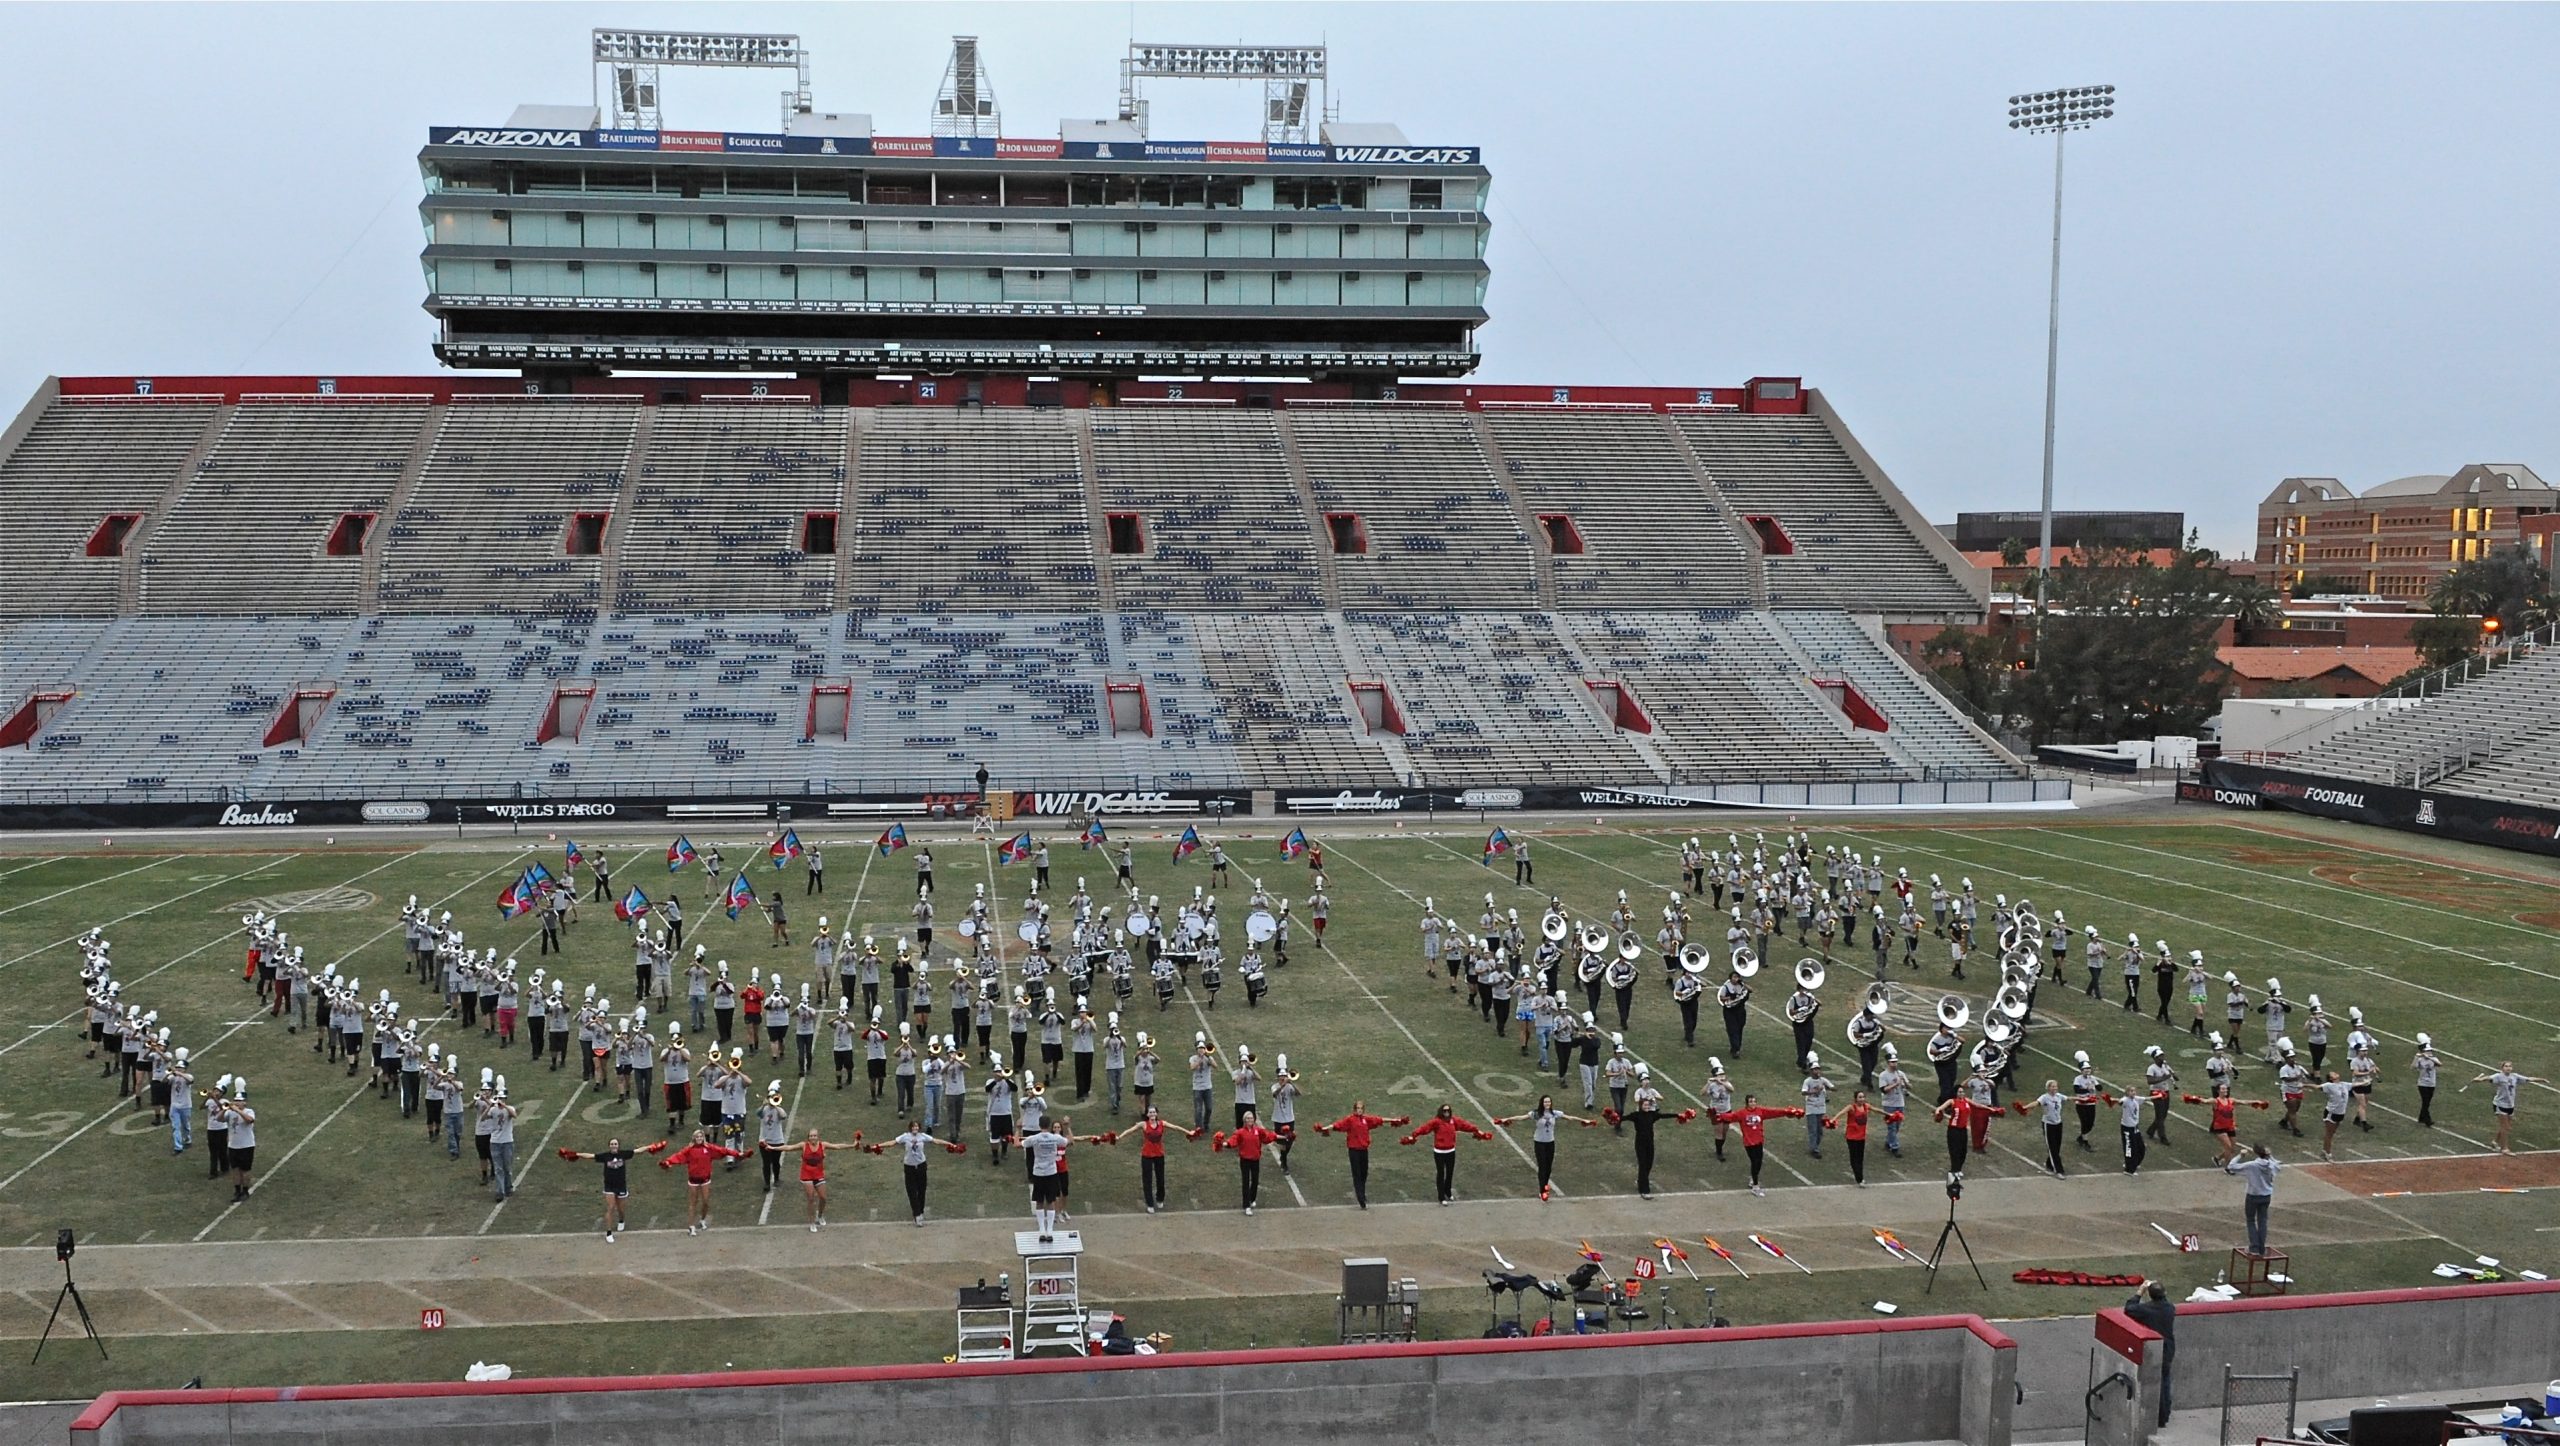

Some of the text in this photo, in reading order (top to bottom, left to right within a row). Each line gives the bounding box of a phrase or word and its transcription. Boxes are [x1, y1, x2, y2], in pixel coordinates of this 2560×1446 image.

[445, 130, 582, 146] ARIZONA
[599, 134, 656, 144] 22 ART LUPPINO
[671, 136, 694, 145] RICKY
[695, 137, 723, 145] HUNLEY
[729, 137, 783, 148] 6 CHUCK CECIL
[872, 142, 933, 151] 4 DARRYLL LEWIS
[1005, 144, 1021, 153] ROB
[1022, 145, 1056, 153] WALDROP
[1154, 146, 1170, 154] STEVE
[1213, 147, 1232, 155] CHRIS
[1273, 148, 1302, 157] ANTOINE
[1303, 149, 1326, 157] CASON
[1336, 148, 1472, 163] WILDCATS
[137, 384, 151, 395] 17
[320, 384, 334, 395] 18
[526, 384, 539, 395] 19
[752, 386, 767, 396] 20
[921, 386, 934, 397] 21
[1168, 389, 1182, 399] 22
[1383, 391, 1397, 401] 23
[1554, 393, 1568, 403] 24
[1698, 395, 1712, 405] 25
[1579, 792, 1634, 804] WELLS
[2214, 789, 2256, 806] DOWN
[2304, 787, 2365, 809] FOOTBALL
[218, 804, 298, 825] Bashas'
[387, 807, 423, 815] CASINOS
[495, 803, 615, 817] WELLS FARGO
[2415, 799, 2437, 825] A
[2184, 1235, 2199, 1252] 30
[1635, 1258, 1651, 1278] 40
[1041, 1278, 1058, 1295] 50
[423, 1310, 442, 1328] 40
